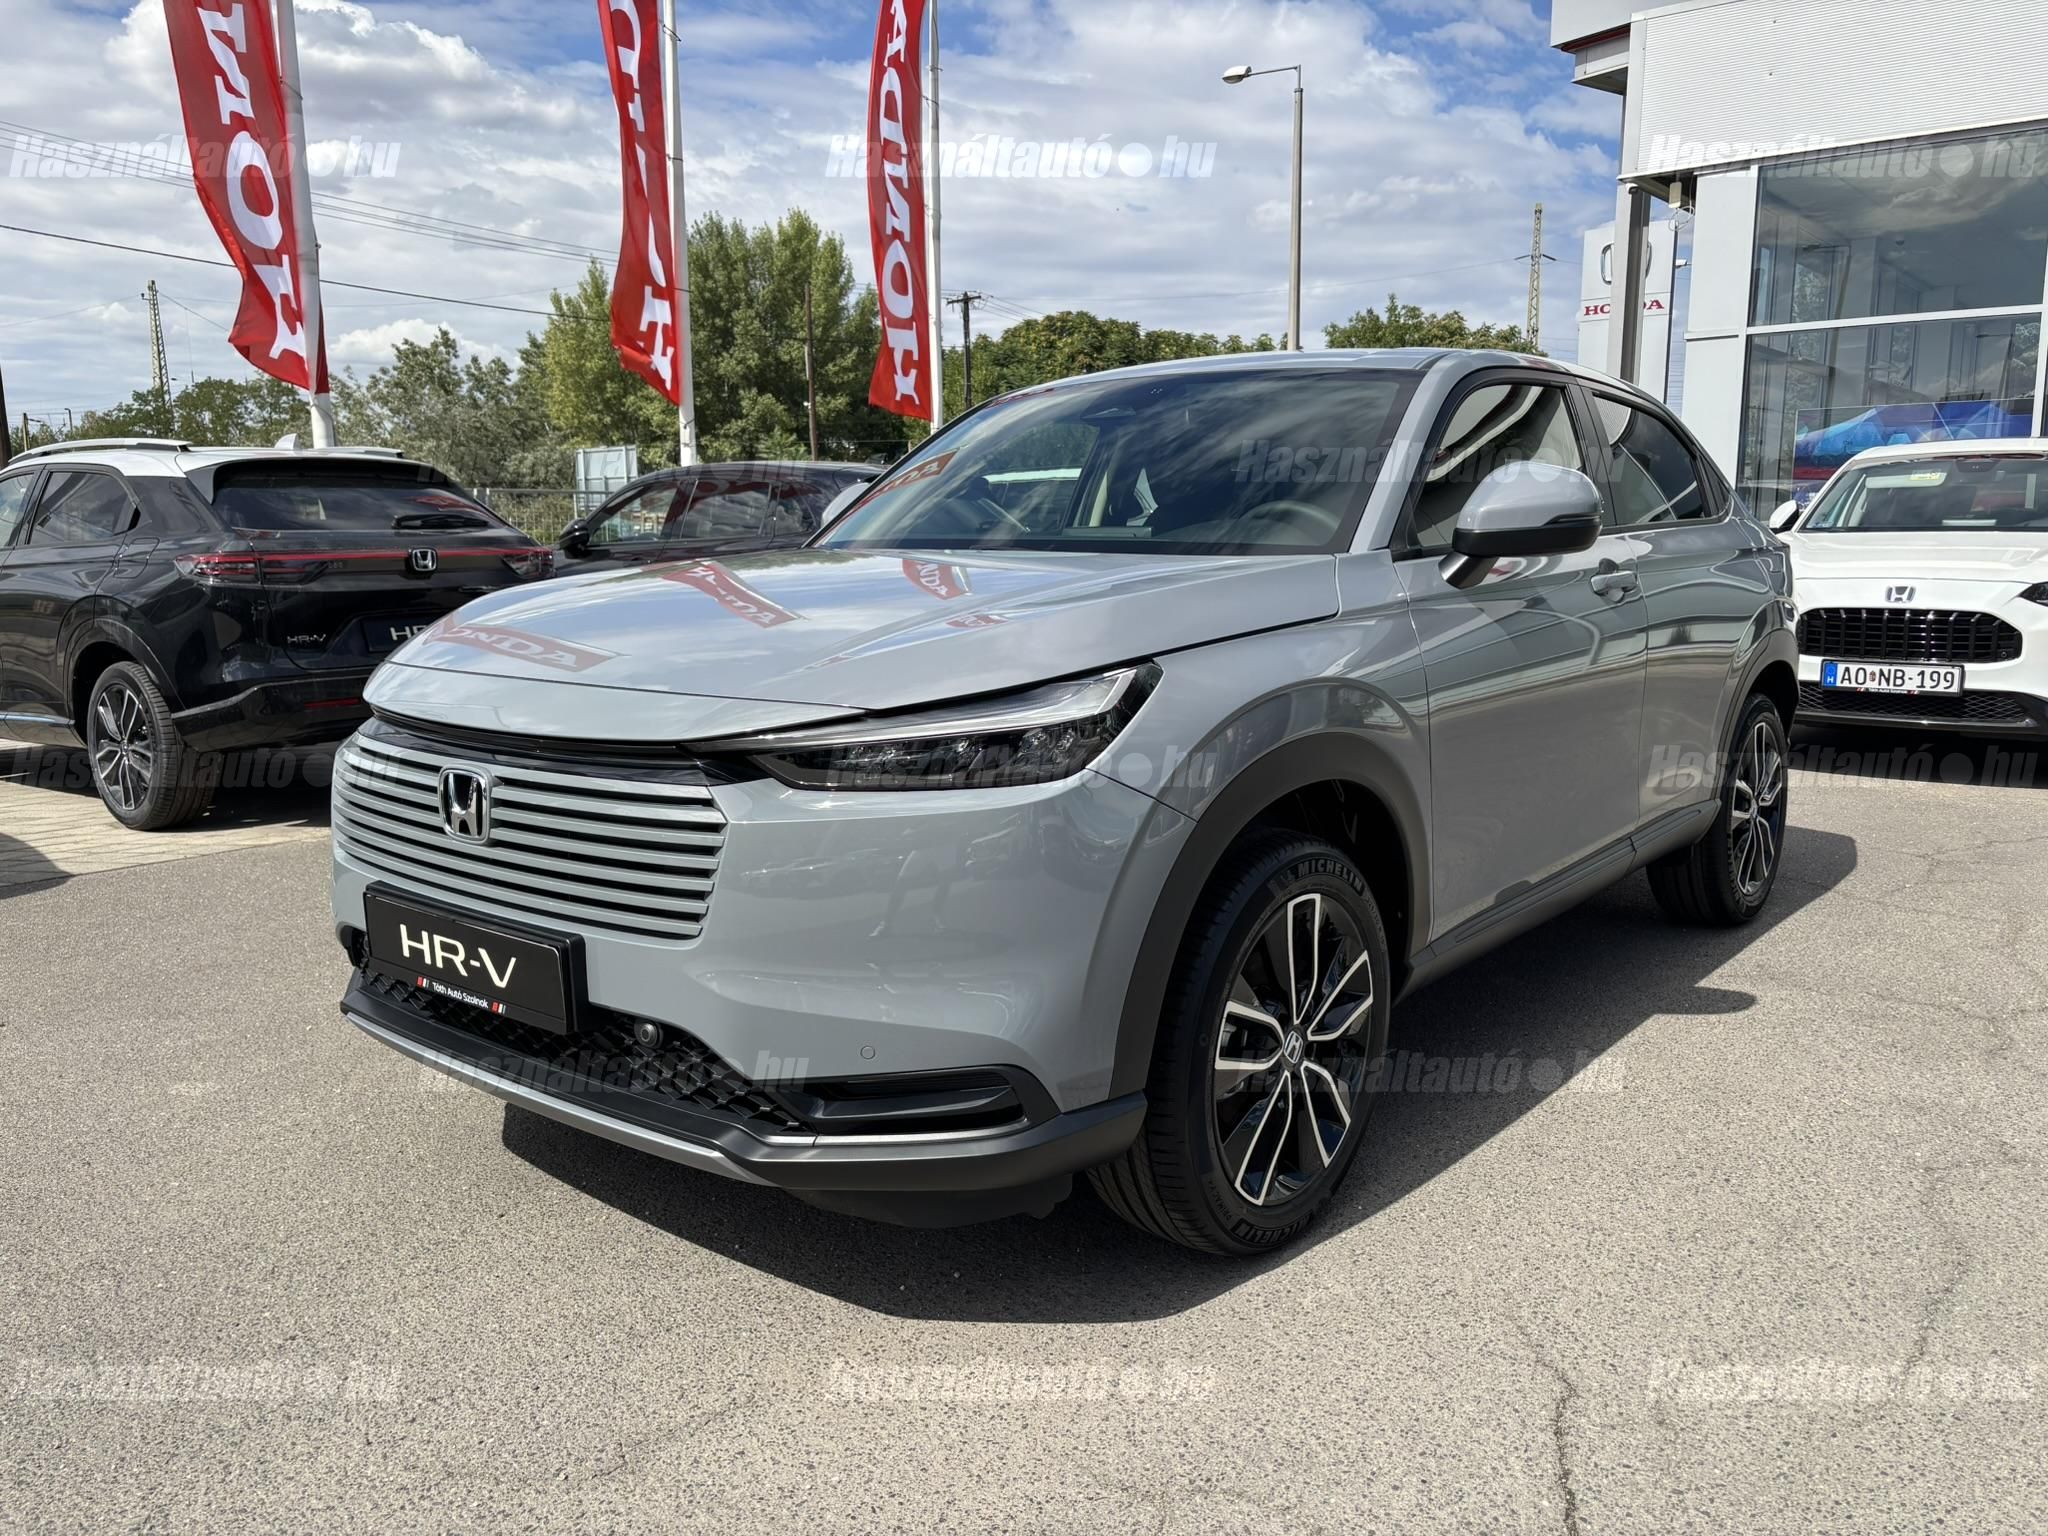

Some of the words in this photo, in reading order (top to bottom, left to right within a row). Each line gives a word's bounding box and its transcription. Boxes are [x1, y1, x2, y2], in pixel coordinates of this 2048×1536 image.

[1297, 858, 1364, 893] MICHELIN
[400, 923, 517, 989] HR-V
[463, 992, 489, 1009] Szolnok
